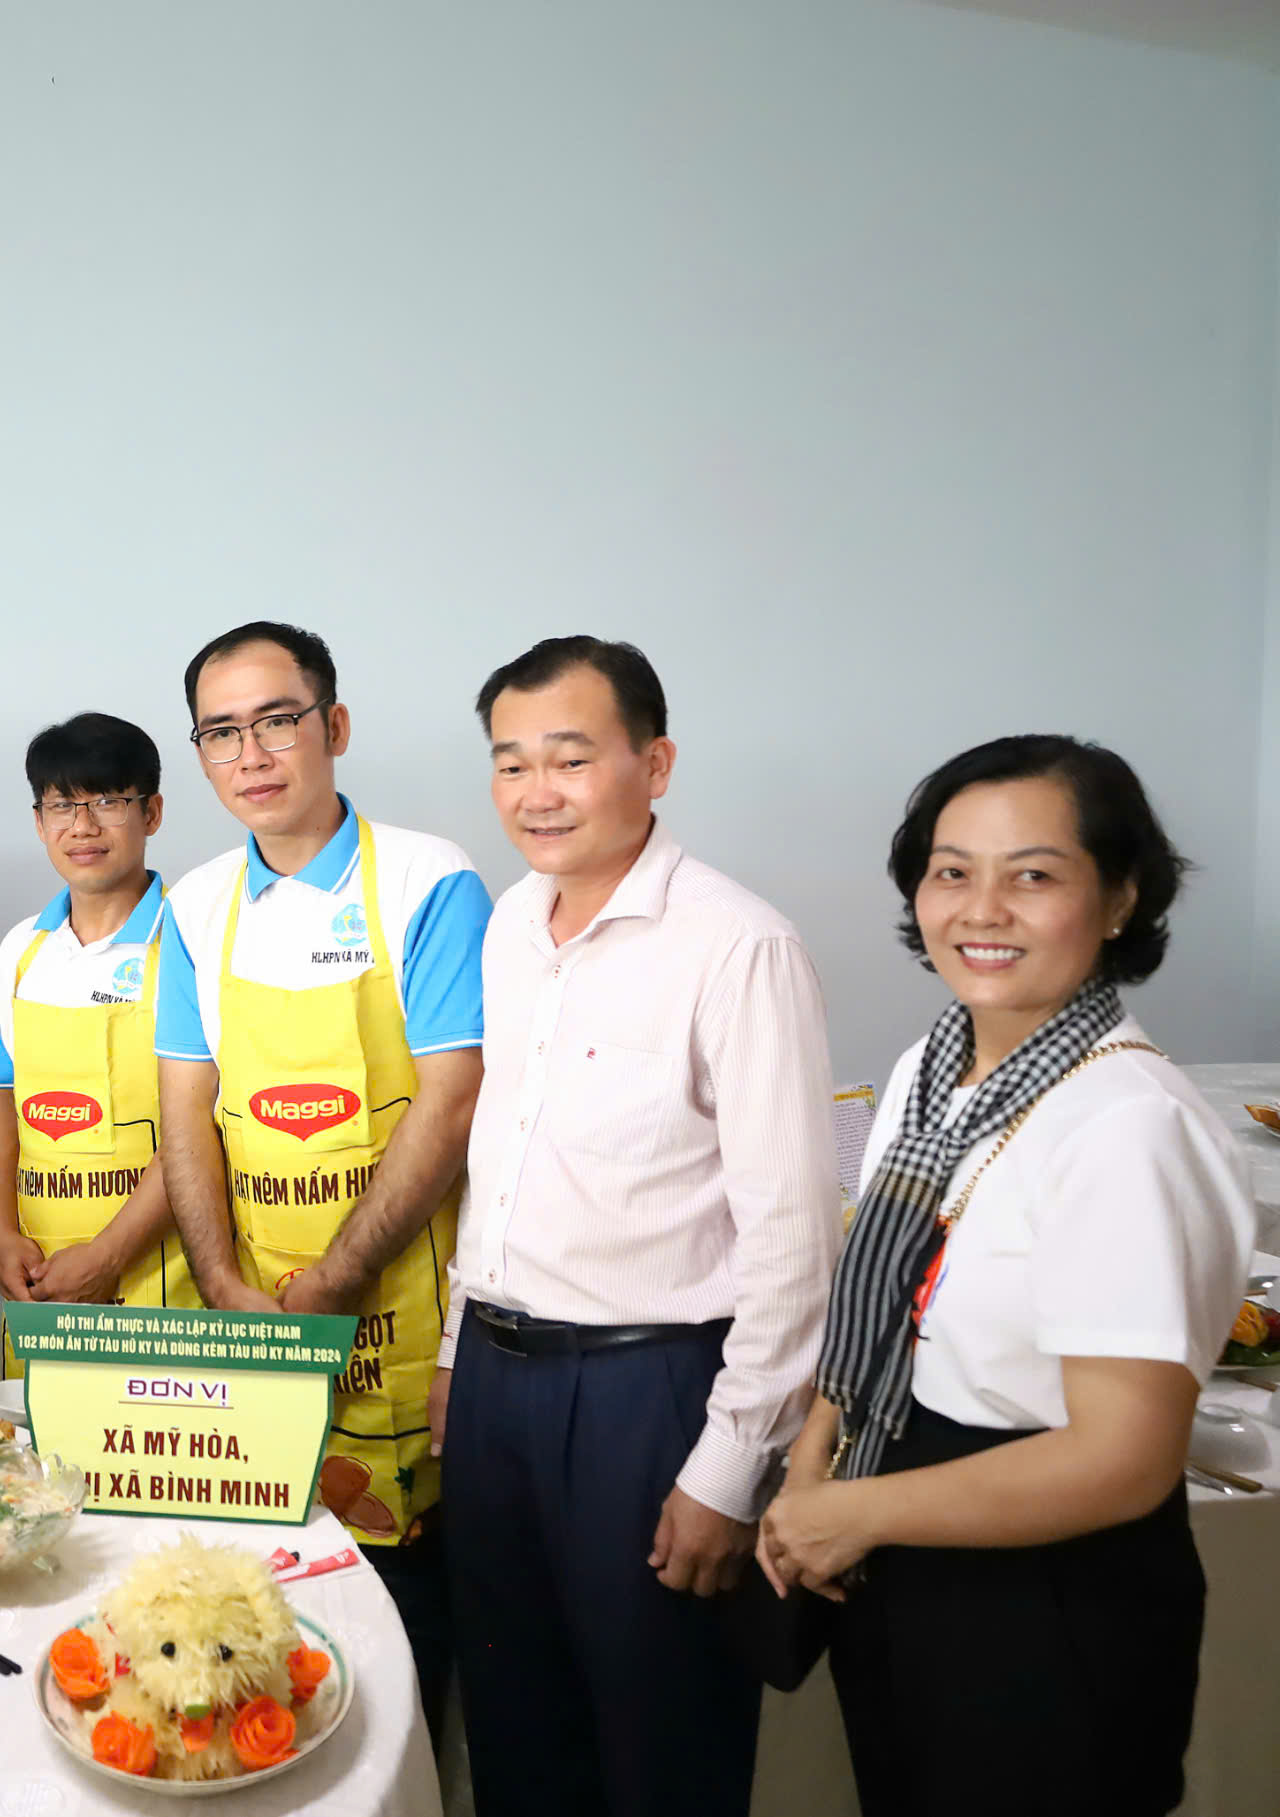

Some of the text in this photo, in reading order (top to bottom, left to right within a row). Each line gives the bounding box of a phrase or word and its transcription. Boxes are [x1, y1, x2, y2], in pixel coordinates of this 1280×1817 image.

[28, 1102, 91, 1122] Maggi
[260, 1094, 346, 1120] Maggi
[47, 1164, 83, 1199] NẤM
[293, 1165, 339, 1206] NẤM
[56, 1313, 76, 1332] HỘI
[77, 1316, 95, 1331] THI
[116, 1317, 144, 1335] THỰC
[146, 1317, 160, 1334] VÀ
[162, 1318, 185, 1335] XÁC
[186, 1319, 208, 1338] LẬP
[225, 1322, 247, 1340] LỤC
[248, 1322, 273, 1341] VIỆT
[274, 1325, 301, 1340] NAM
[18, 1335, 37, 1349] 102
[99, 1336, 120, 1353] TÀU
[138, 1339, 152, 1354] KY
[154, 1338, 169, 1355] VÀ
[229, 1342, 250, 1359] TÀU
[269, 1346, 284, 1360] KY
[313, 1348, 342, 1364] 2024
[127, 1378, 227, 1406] ĐƠN VỊ
[103, 1424, 249, 1464] XÃ MỸ HÒA,
[109, 1468, 142, 1499] XÃ
[150, 1471, 212, 1503] BÌNH
[220, 1479, 289, 1509] MINH
